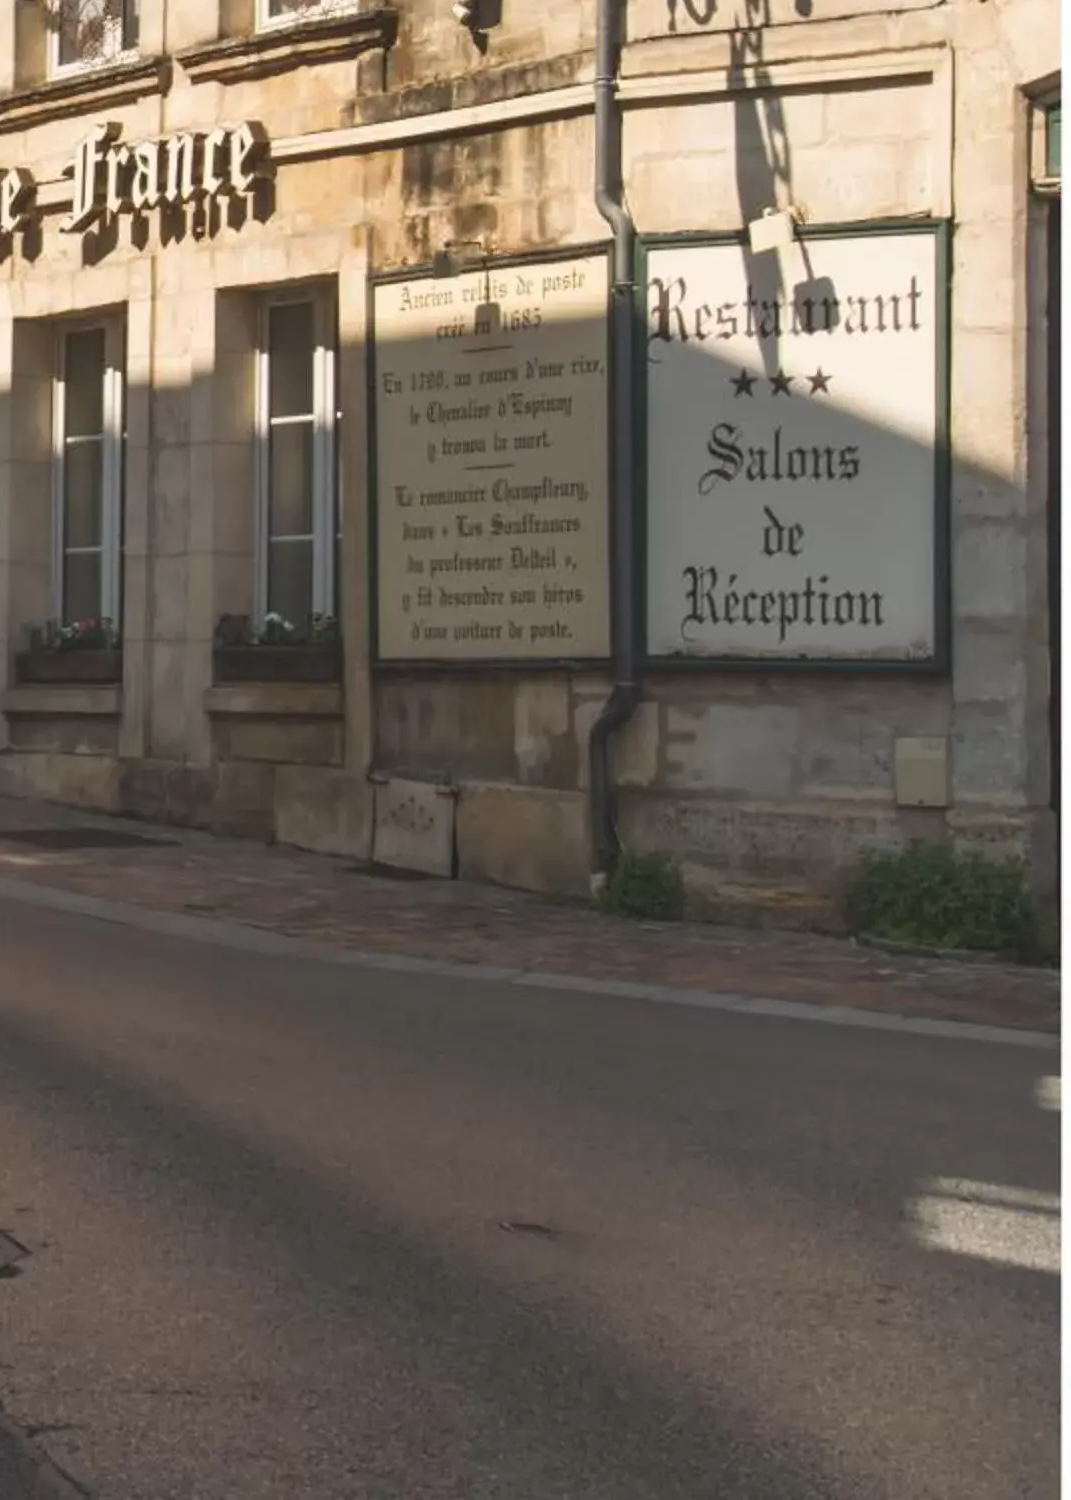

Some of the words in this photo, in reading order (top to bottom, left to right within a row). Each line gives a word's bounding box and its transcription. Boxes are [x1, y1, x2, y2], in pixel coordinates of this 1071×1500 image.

[60, 121, 267, 233] France
[400, 285, 454, 312] Ancien
[516, 275, 532, 296] de
[542, 266, 586, 299] poste
[647, 275, 922, 364] Restaurant
[382, 372, 403, 394] En
[479, 367, 519, 385] cours
[526, 357, 565, 380] d'une
[698, 422, 861, 495] Salons
[761, 504, 805, 556] de
[438, 585, 504, 607] descendre
[681, 565, 884, 643] Réception
[509, 618, 524, 640] de
